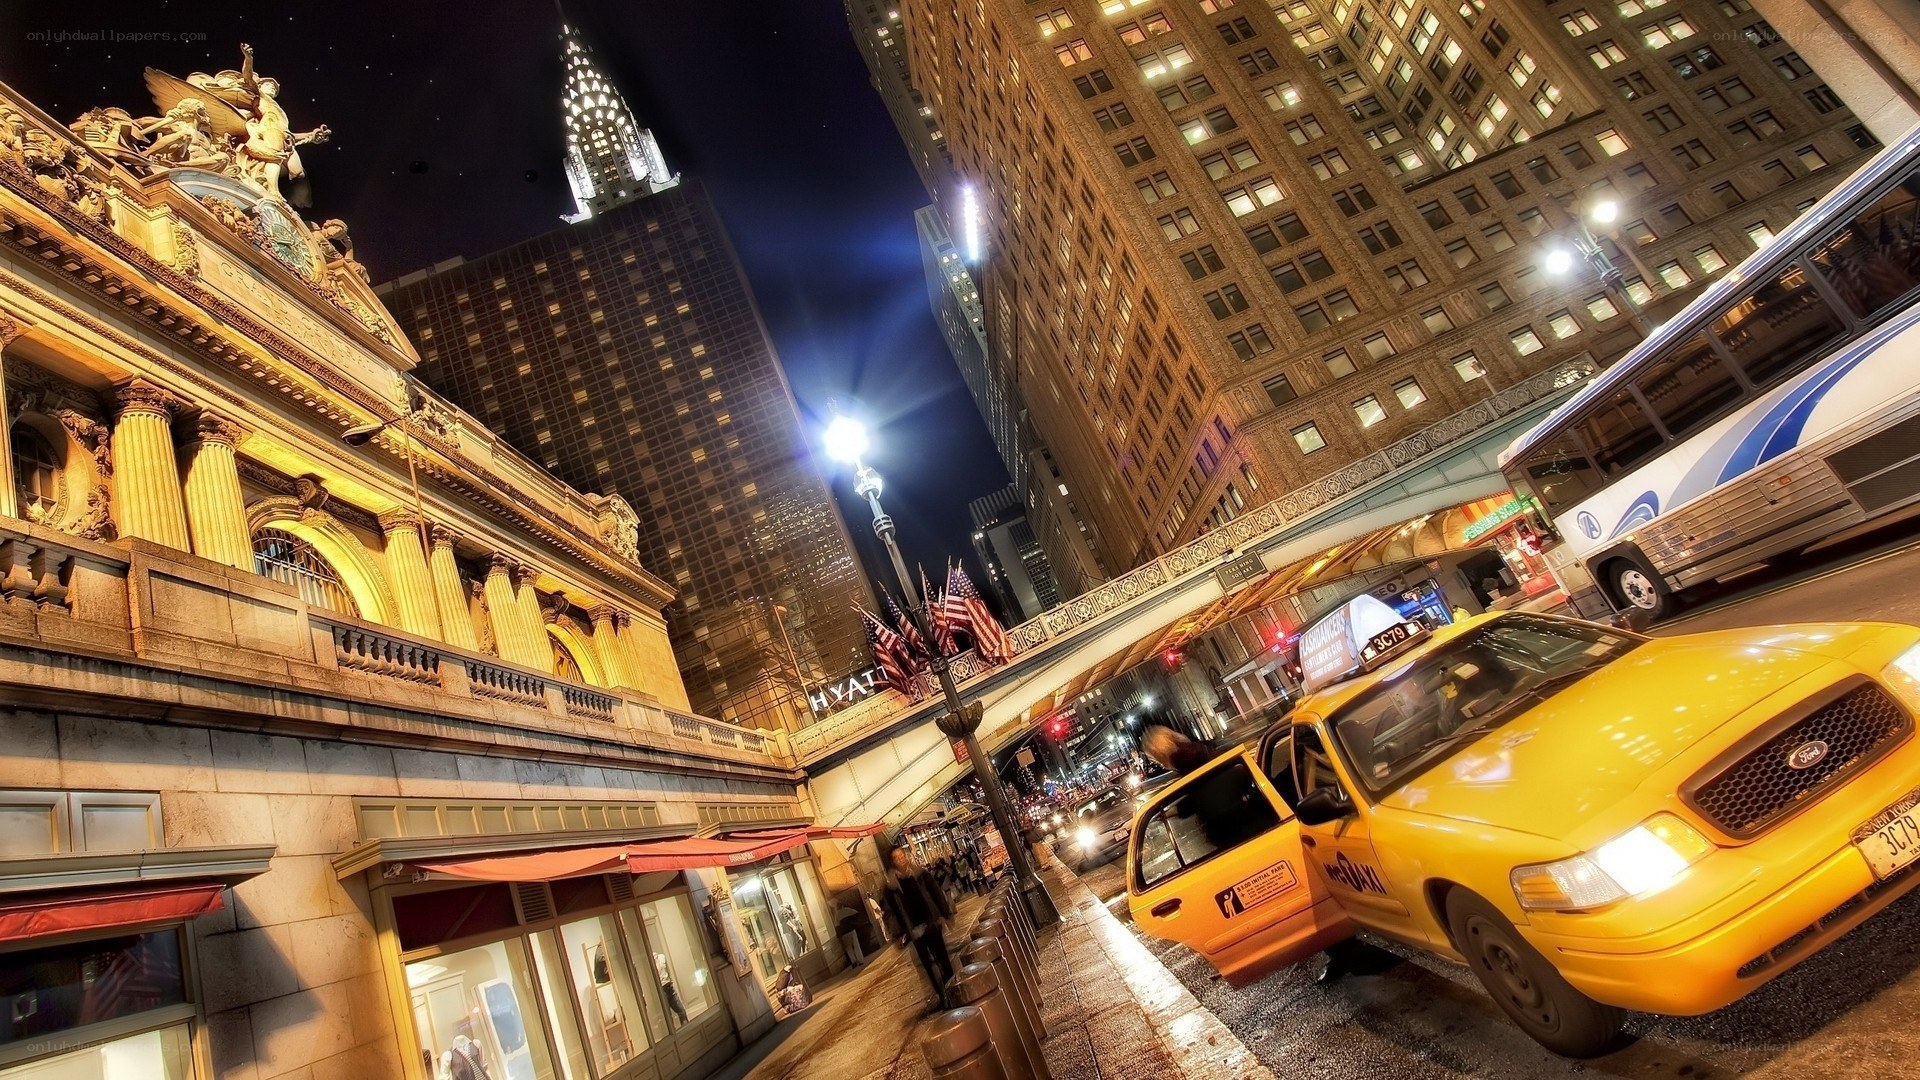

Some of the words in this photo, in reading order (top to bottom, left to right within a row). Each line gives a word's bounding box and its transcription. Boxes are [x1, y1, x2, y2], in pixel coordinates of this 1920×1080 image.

[1225, 558, 1254, 575] PERSHING
[1231, 566, 1253, 579] SQUARE
[1374, 626, 1406, 651] 3C79
[810, 665, 889, 712] HYATT
[1798, 747, 1821, 764] Ford
[1871, 810, 1892, 832] NEW
[1890, 797, 1917, 819] YORK
[1879, 815, 1920, 856] 3C79
[1251, 871, 1270, 884] INITIAL
[1270, 864, 1285, 874] FARE
